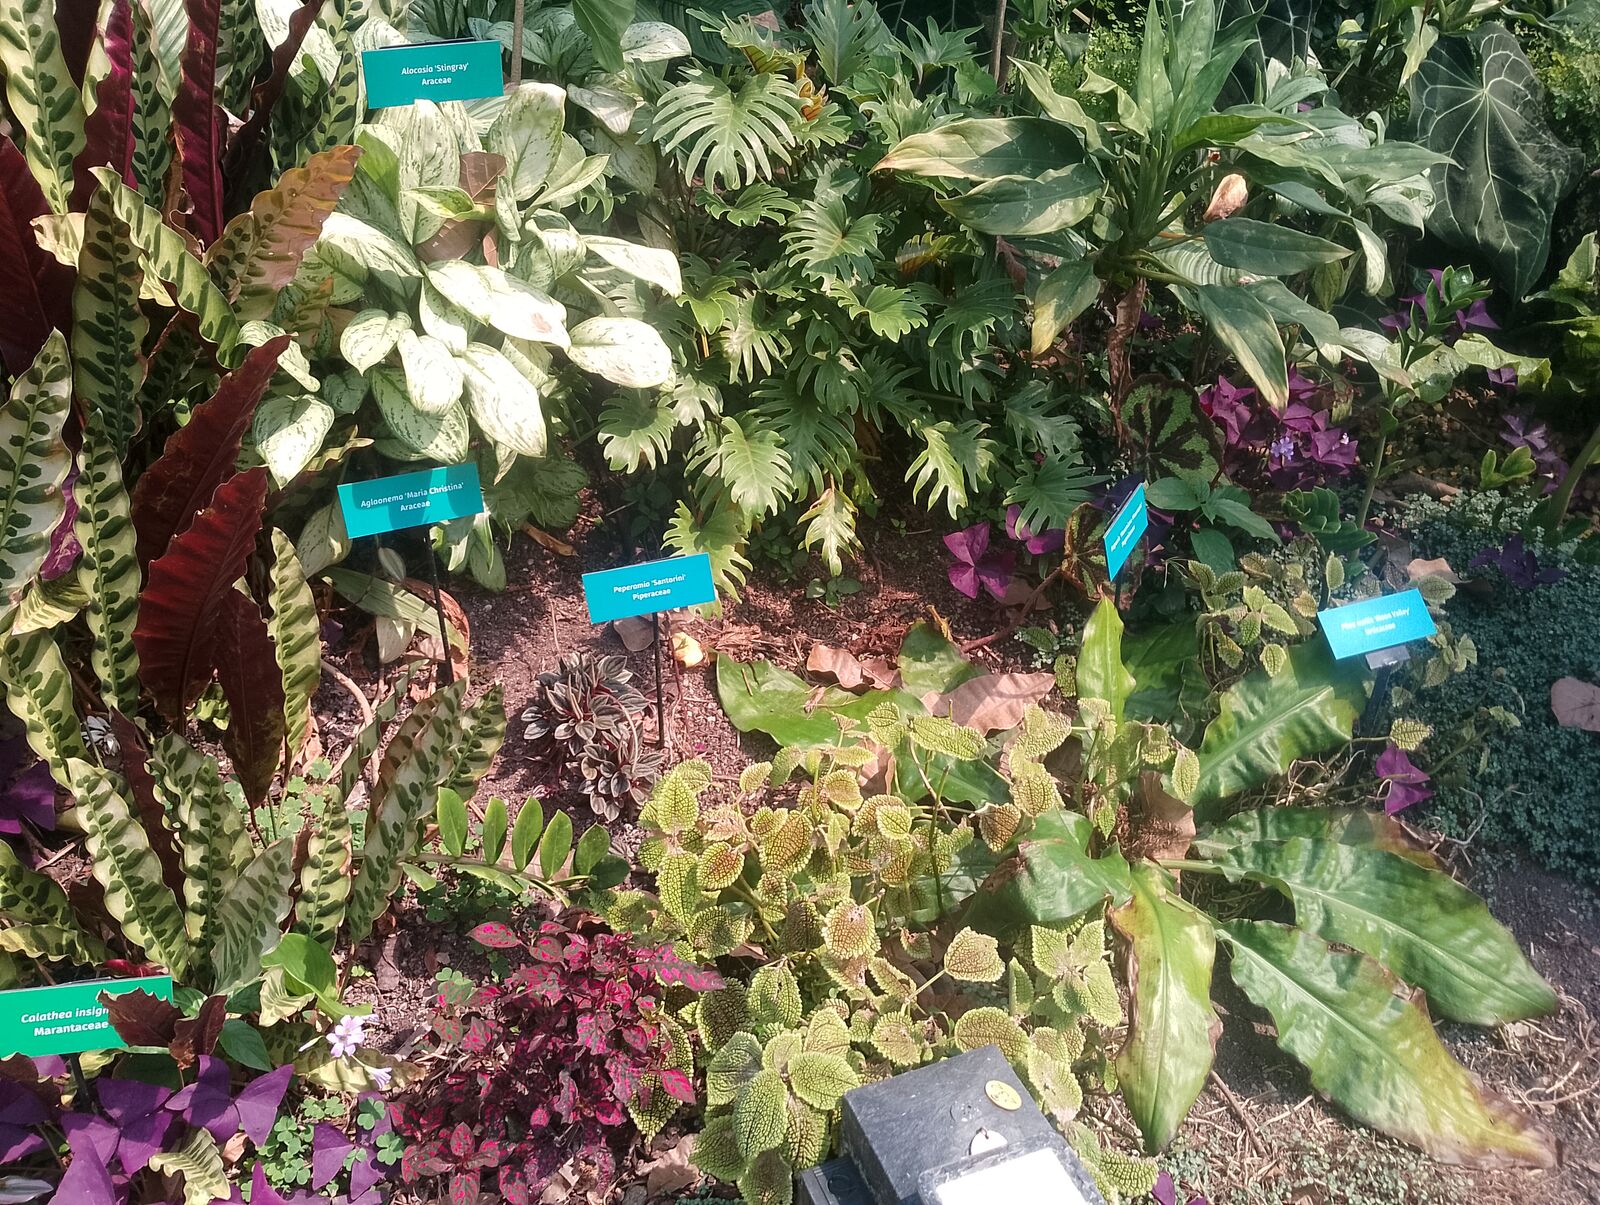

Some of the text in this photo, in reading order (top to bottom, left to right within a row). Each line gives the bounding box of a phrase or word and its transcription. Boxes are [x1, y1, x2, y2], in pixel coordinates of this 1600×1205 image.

[421, 77, 452, 86] Araceae
[404, 489, 428, 499] 'Maria
[429, 482, 465, 495] Christina'
[400, 501, 431, 511] Araceae
[632, 588, 671, 601] Piperaceae
[21, 1009, 72, 1023] Calathea
[34, 1021, 109, 1037] Marantaceae
